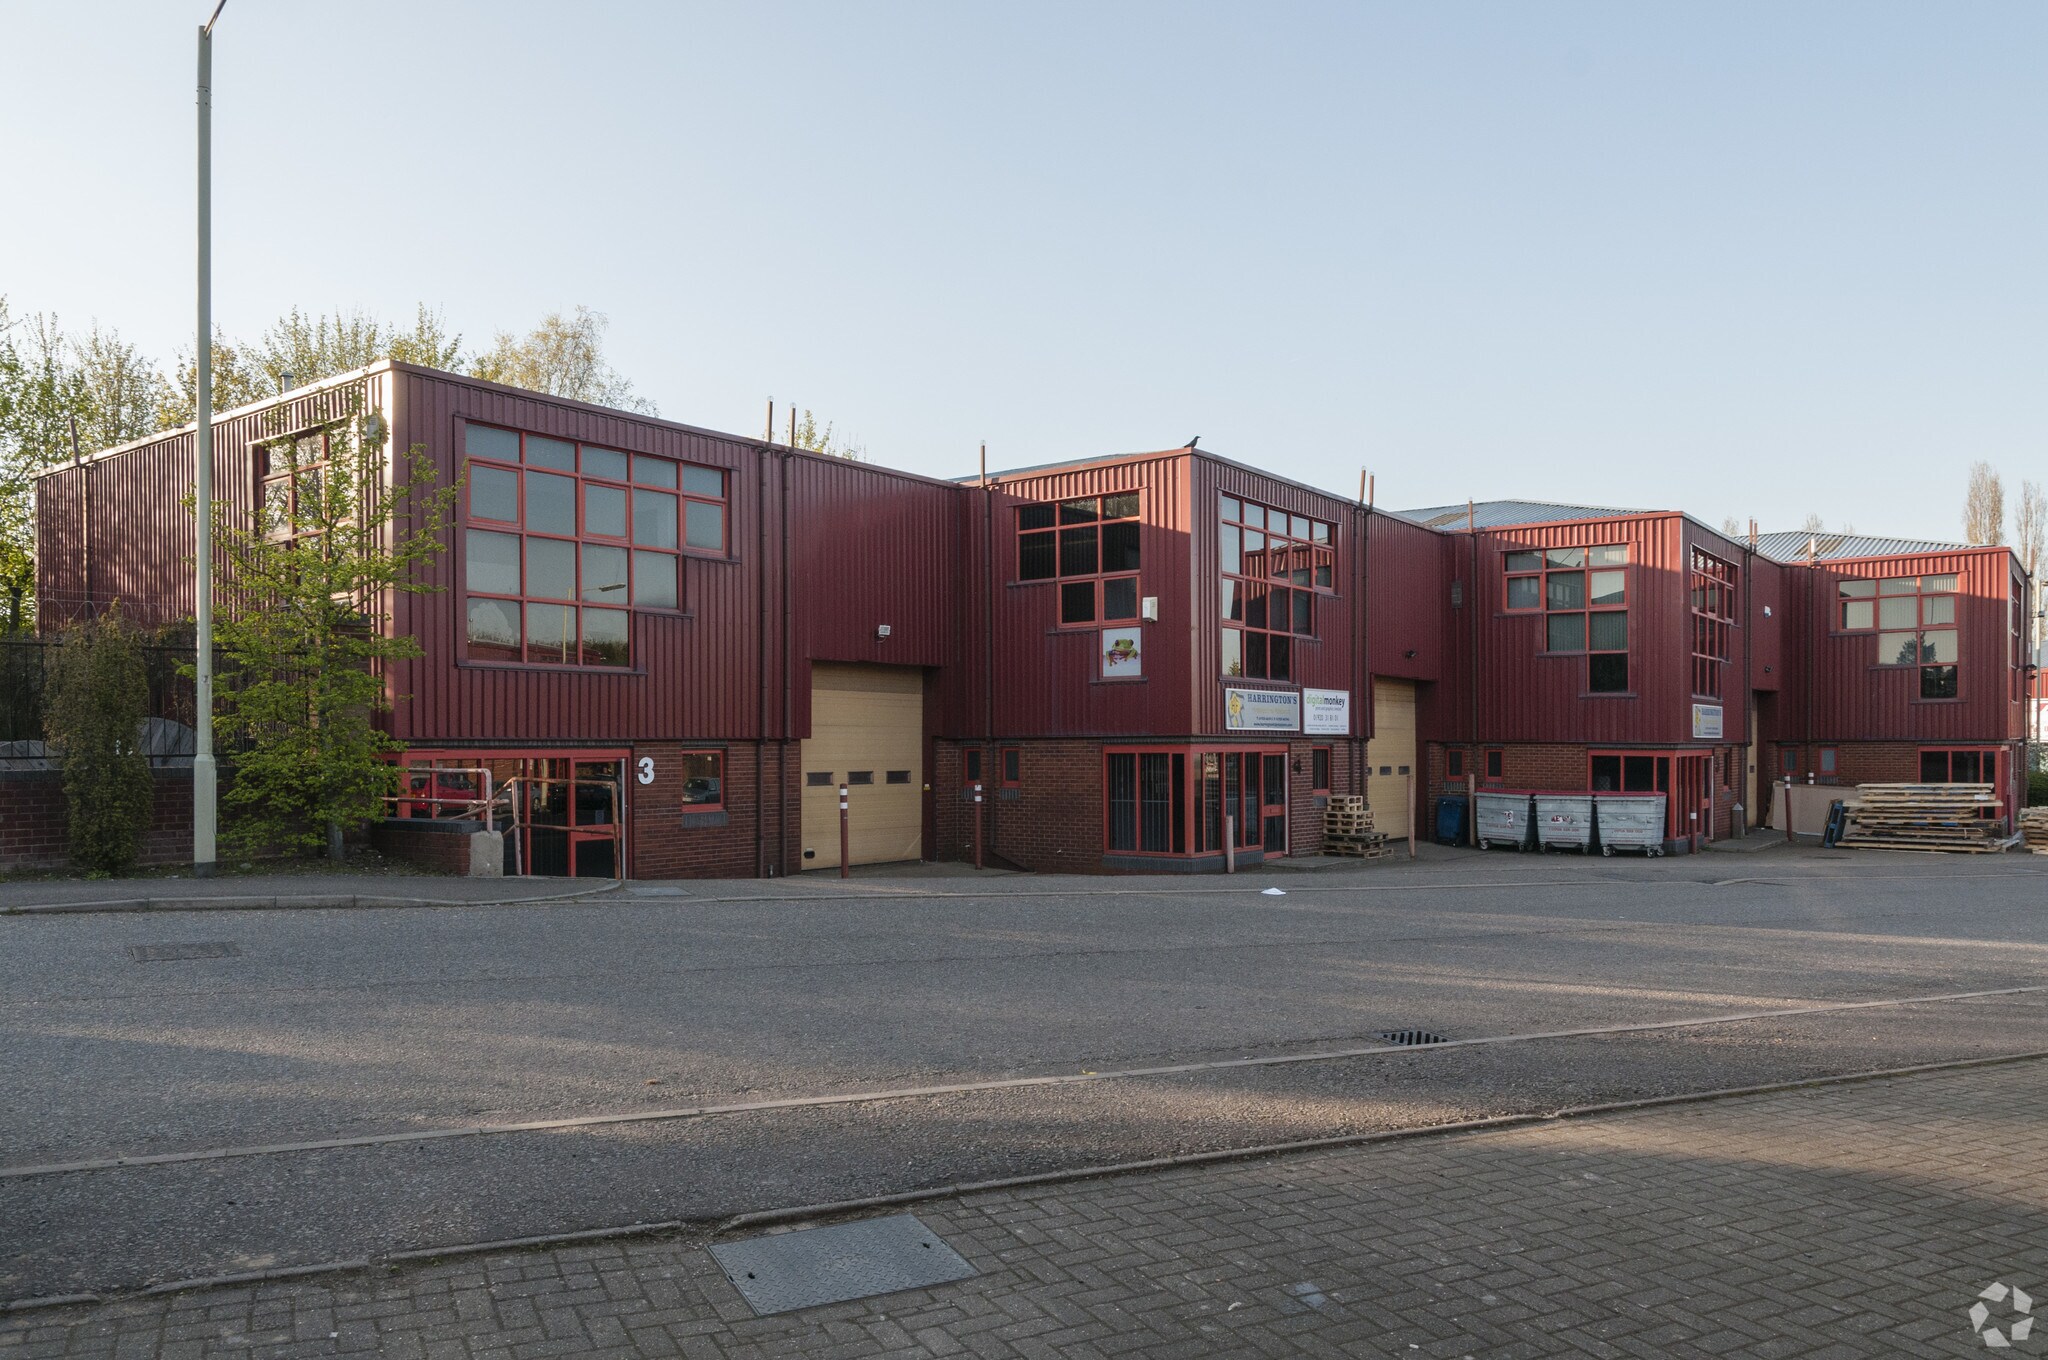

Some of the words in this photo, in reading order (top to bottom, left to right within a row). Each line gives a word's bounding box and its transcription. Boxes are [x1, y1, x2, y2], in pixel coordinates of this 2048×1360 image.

[1247, 693, 1297, 704] HARRINGTON'S
[1306, 694, 1345, 708] digitalmonkey
[638, 757, 655, 785] 3
